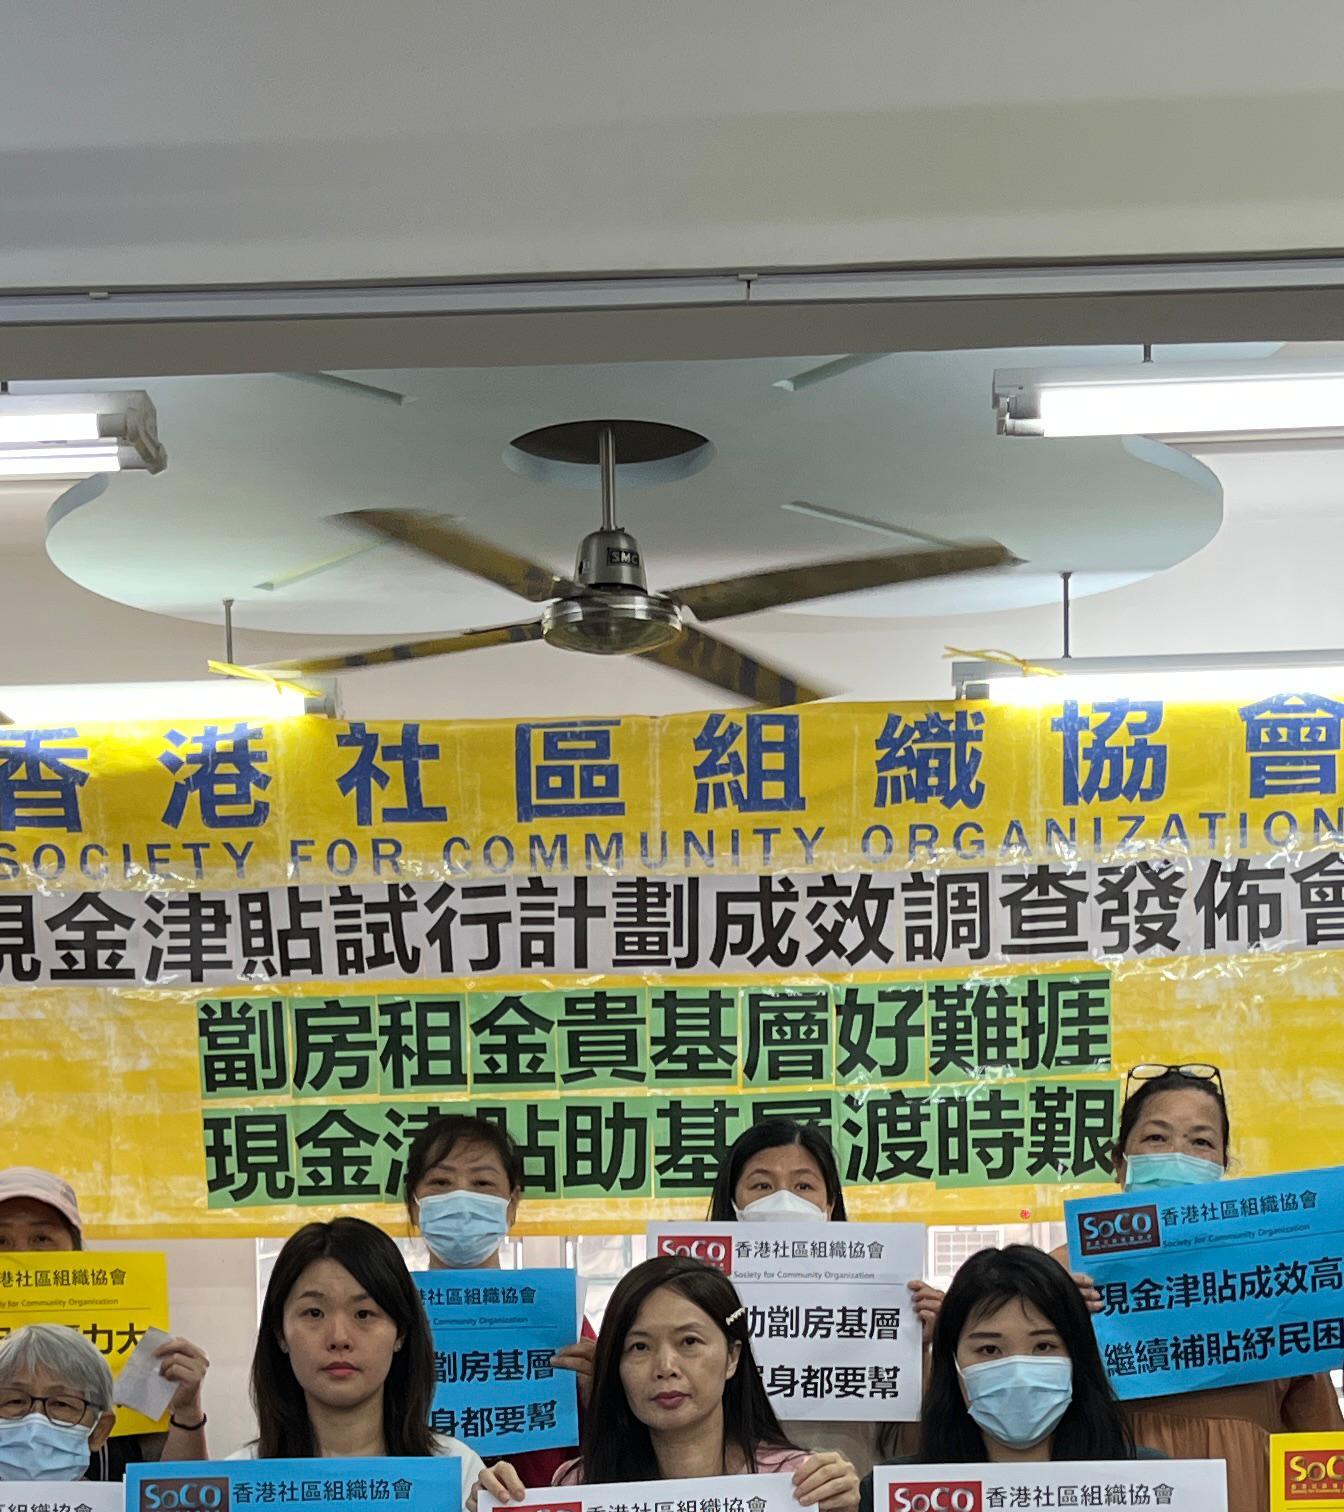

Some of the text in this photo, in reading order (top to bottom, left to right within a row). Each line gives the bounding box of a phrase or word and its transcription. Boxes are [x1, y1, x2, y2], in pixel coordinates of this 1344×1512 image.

[292, 838, 405, 878] FOR
[443, 826, 826, 875] COMMUNITY
[199, 979, 1111, 1094] 劏房租金貴基層好難捱
[1162, 1190, 1317, 1227] 香港社區組織協會
[736, 1241, 885, 1259] 香港社區組織協會
[1094, 1257, 1343, 1317] 現金津貼成效高
[1106, 1317, 1344, 1377] 繼續補貼紓民困
[756, 1365, 900, 1399] 身都要幫
[233, 1478, 413, 1504] 香港社區組織協會
[985, 1483, 1174, 1509] 香港社區組織協會
